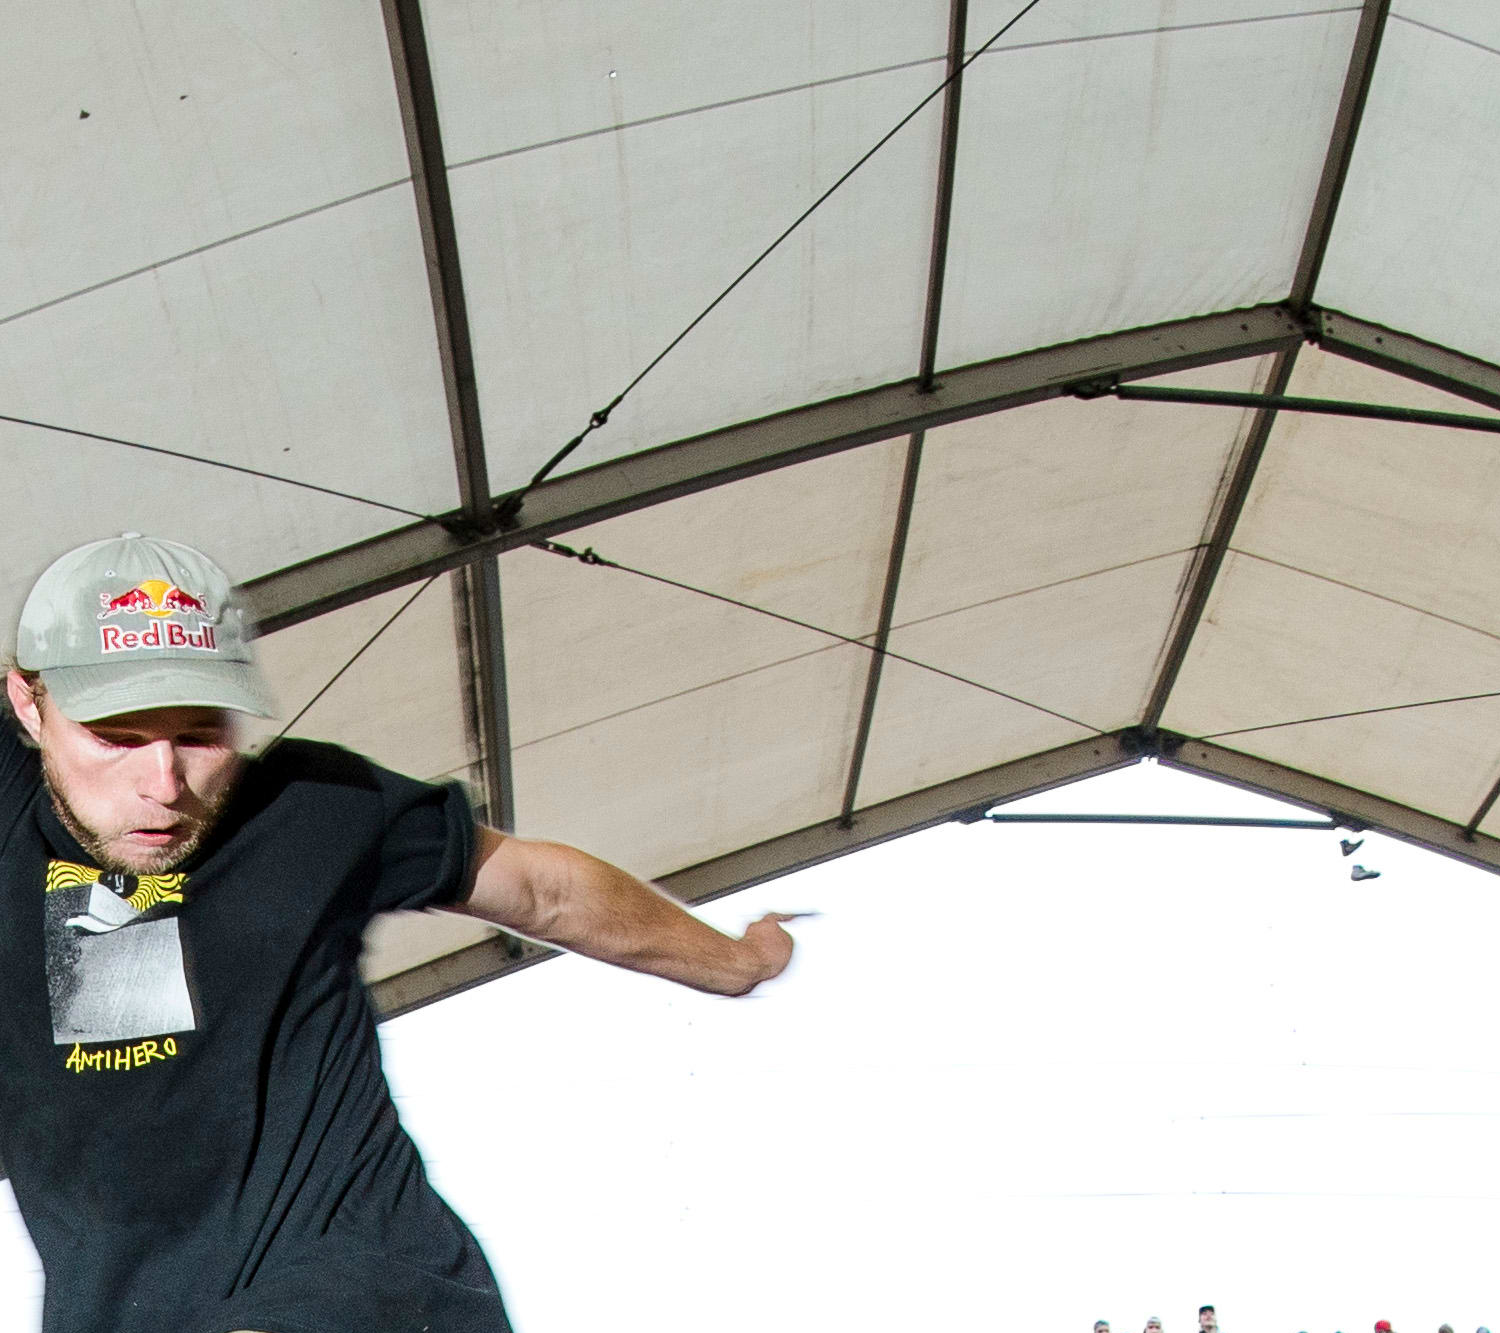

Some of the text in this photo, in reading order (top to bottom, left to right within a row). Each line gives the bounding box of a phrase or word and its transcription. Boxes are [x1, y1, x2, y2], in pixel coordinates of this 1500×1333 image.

[102, 621, 217, 651] Red Bull
[65, 1037, 178, 1074] ANTIHERO
